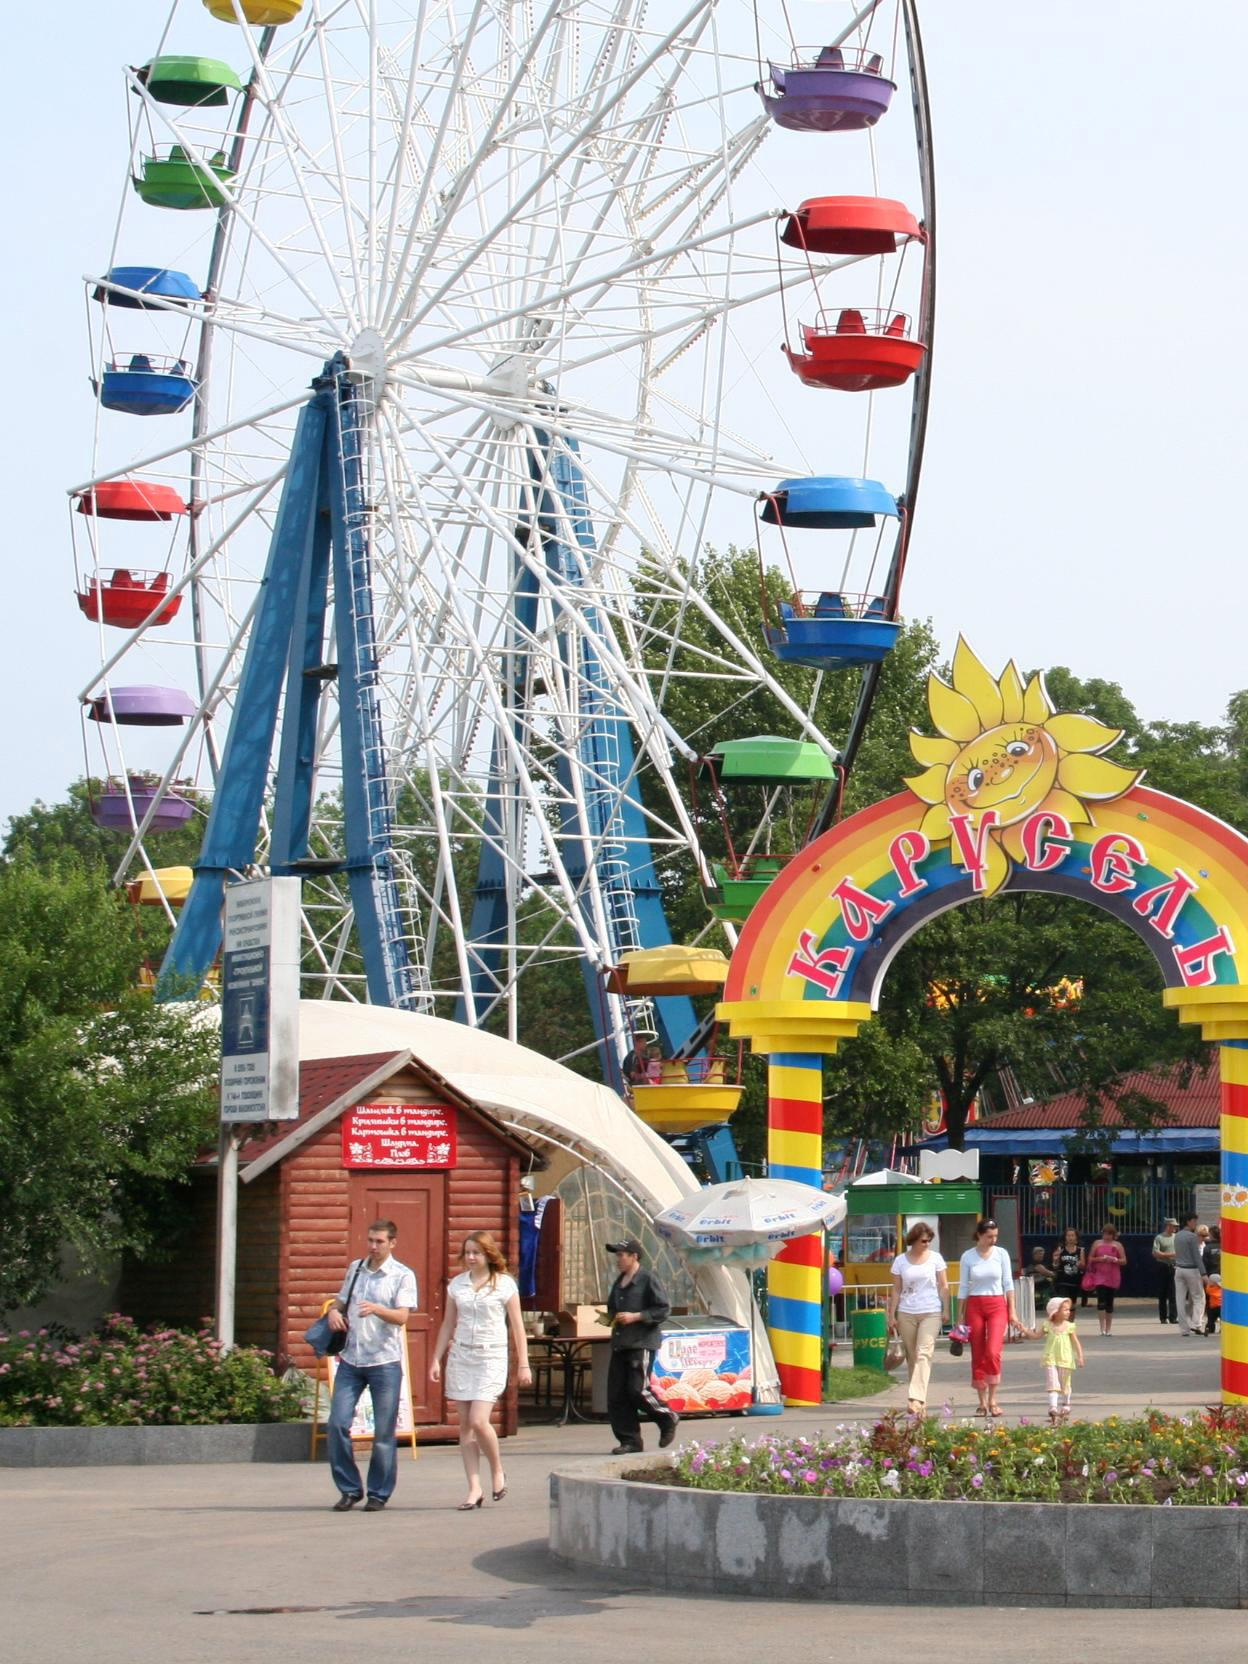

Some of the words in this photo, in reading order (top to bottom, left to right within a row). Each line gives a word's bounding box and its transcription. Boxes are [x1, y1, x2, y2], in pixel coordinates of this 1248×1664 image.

[763, 1213, 796, 1223] Orbit
[696, 1235, 725, 1243] Orbit
[767, 1230, 796, 1240] Orbit
